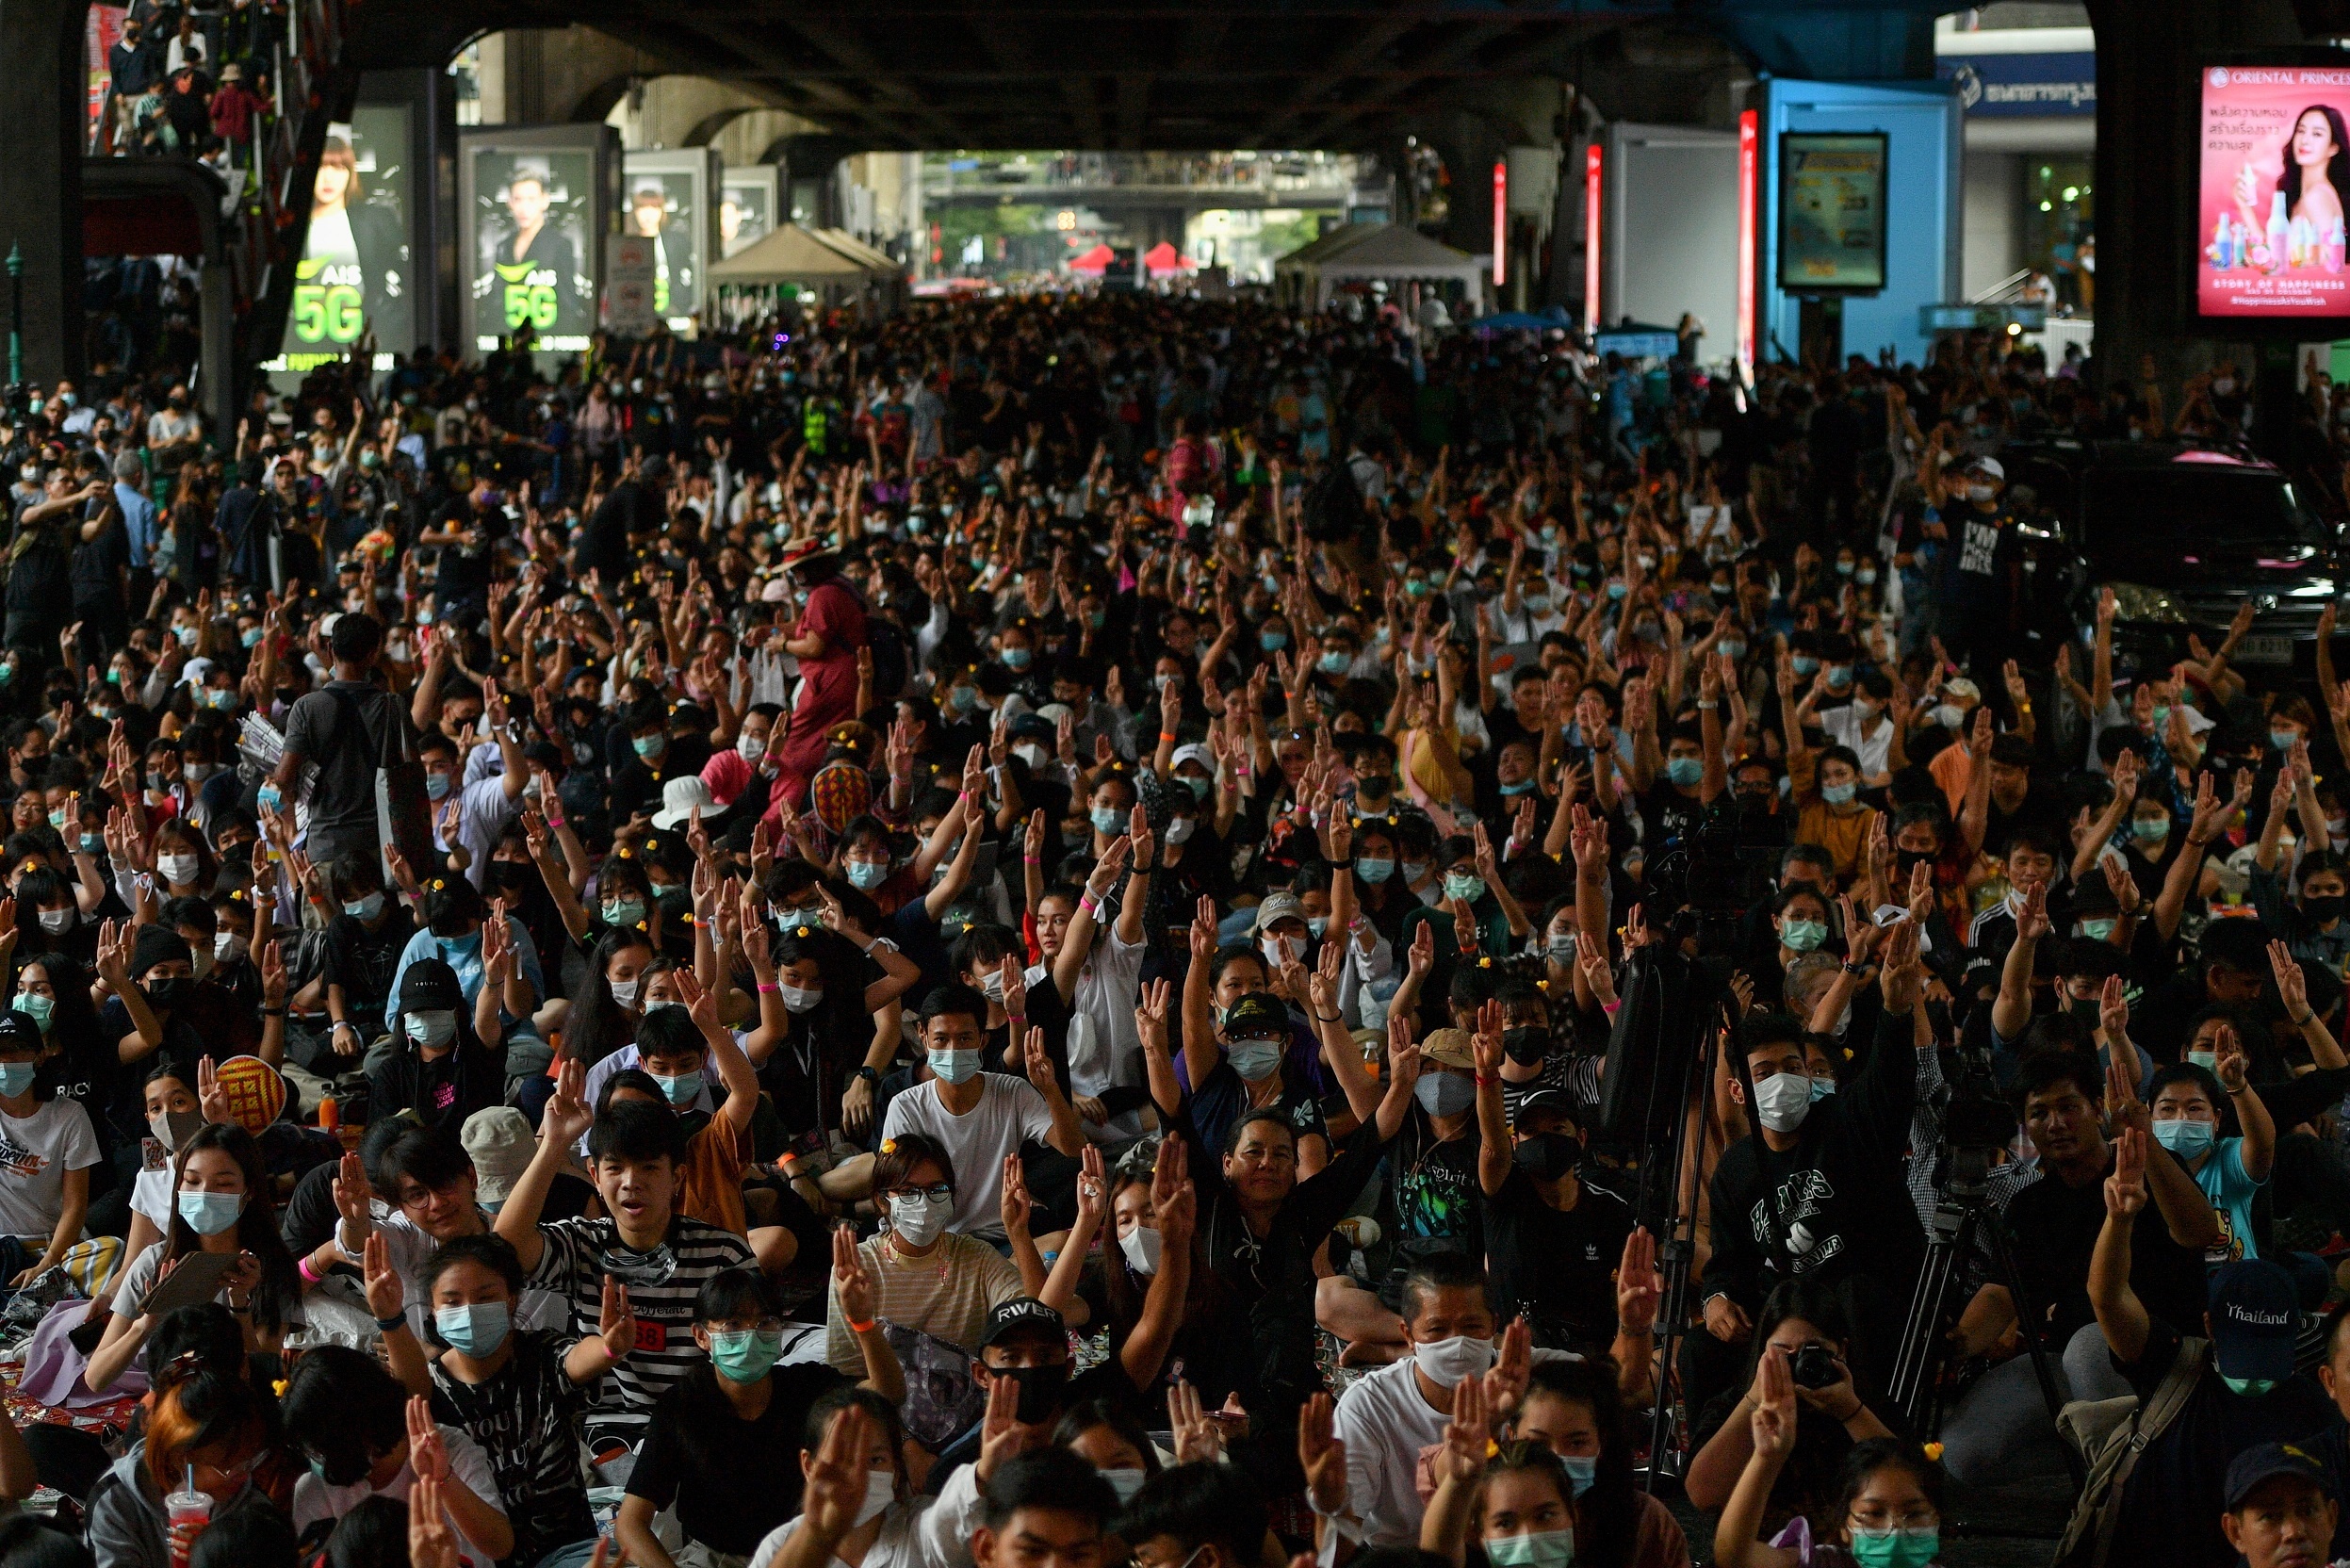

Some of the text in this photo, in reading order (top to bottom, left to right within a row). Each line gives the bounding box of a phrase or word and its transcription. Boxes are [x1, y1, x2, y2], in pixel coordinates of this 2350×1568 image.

[2231, 71, 2295, 85] ORIENTAL
[320, 264, 363, 286] AIS
[524, 269, 558, 287] AIS
[2212, 279, 2346, 290] STORY OF HAPPINESS
[294, 285, 364, 343] 5G
[504, 285, 558, 330] 5G
[436, 1096, 455, 1109] LOVE
[438, 1092, 452, 1102] YOU
[998, 1301, 1056, 1323] RIVER
[2227, 1301, 2290, 1325] Thailand
